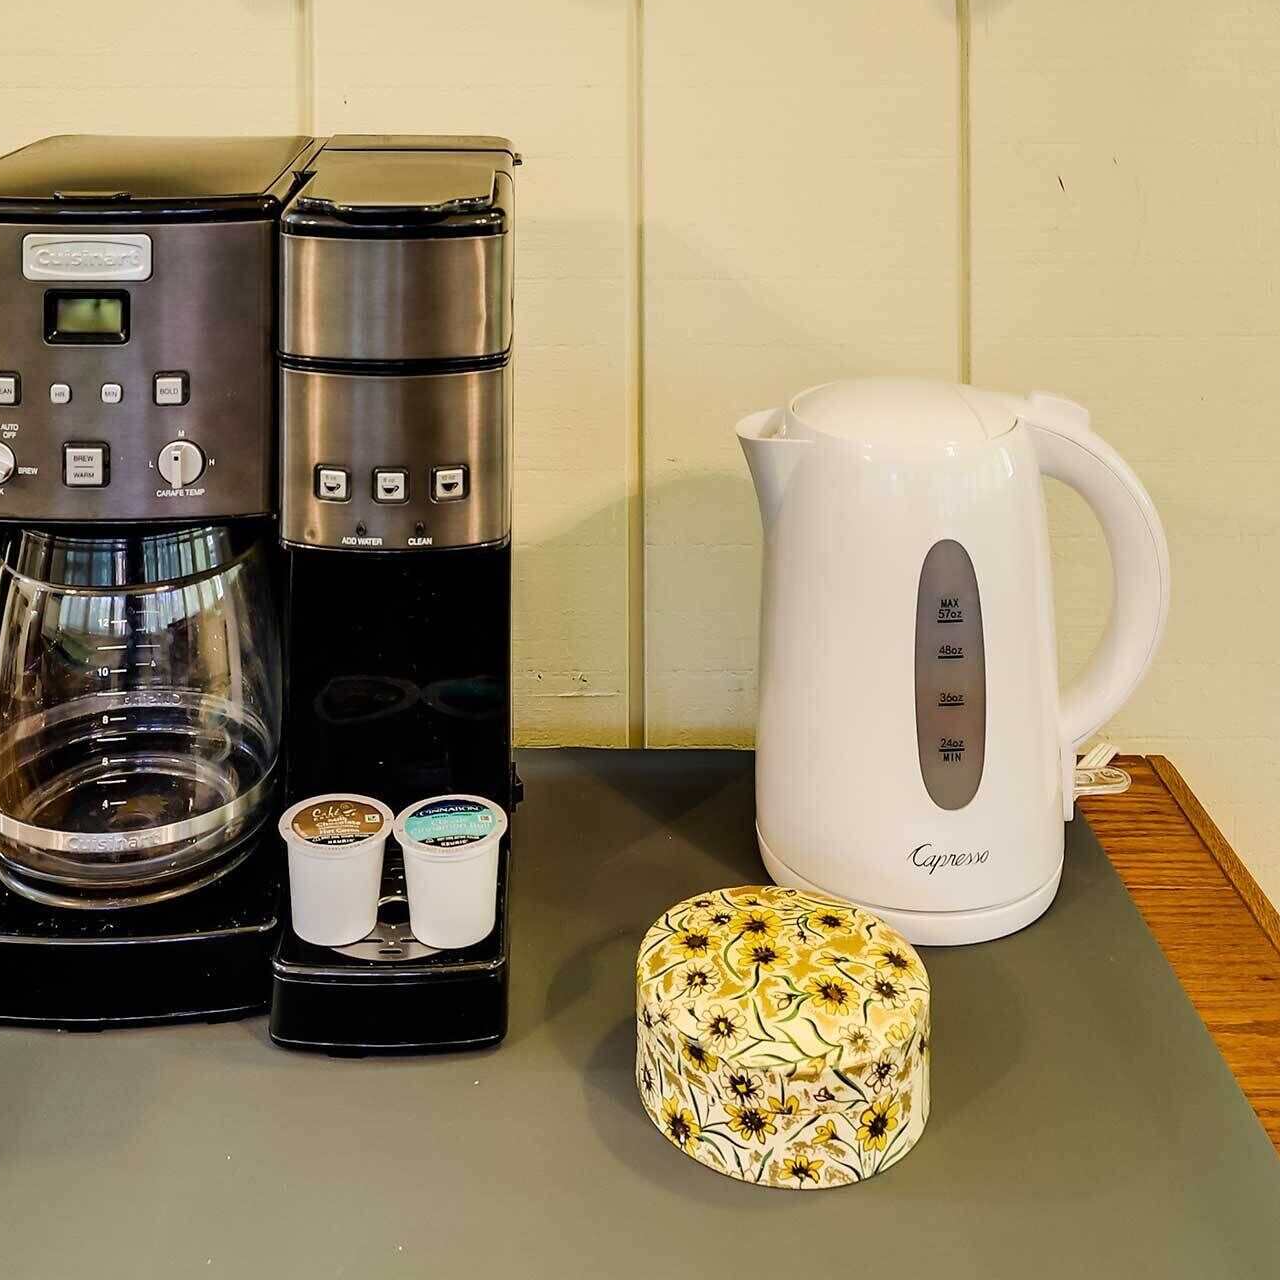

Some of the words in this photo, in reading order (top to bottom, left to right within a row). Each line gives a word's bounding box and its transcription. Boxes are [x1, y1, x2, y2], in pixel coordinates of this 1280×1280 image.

[35, 248, 142, 267] Cuisinart
[159, 388, 179, 396] BOLD
[1, 423, 19, 431] AUTO
[2, 431, 17, 440] OFF
[73, 455, 94, 463] BREW
[208, 458, 215, 467] H
[148, 461, 153, 469] L
[18, 467, 39, 475] BREW
[73, 471, 95, 479] WARM
[156, 488, 184, 498] CARAFE
[184, 488, 206, 498] TEMP
[341, 536, 358, 547] ADD
[358, 536, 383, 547] WATER
[407, 537, 433, 547] CLEAN
[940, 599, 960, 609] MAX
[938, 608, 963, 619] 57oz
[98, 618, 109, 628] 12
[938, 645, 963, 656] 48oz
[97, 667, 109, 677] 10
[939, 692, 964, 703] 36oz
[940, 738, 964, 749] 24oz
[943, 752, 962, 762] MIN
[101, 799, 109, 809] 4
[907, 842, 990, 875] Capresso
